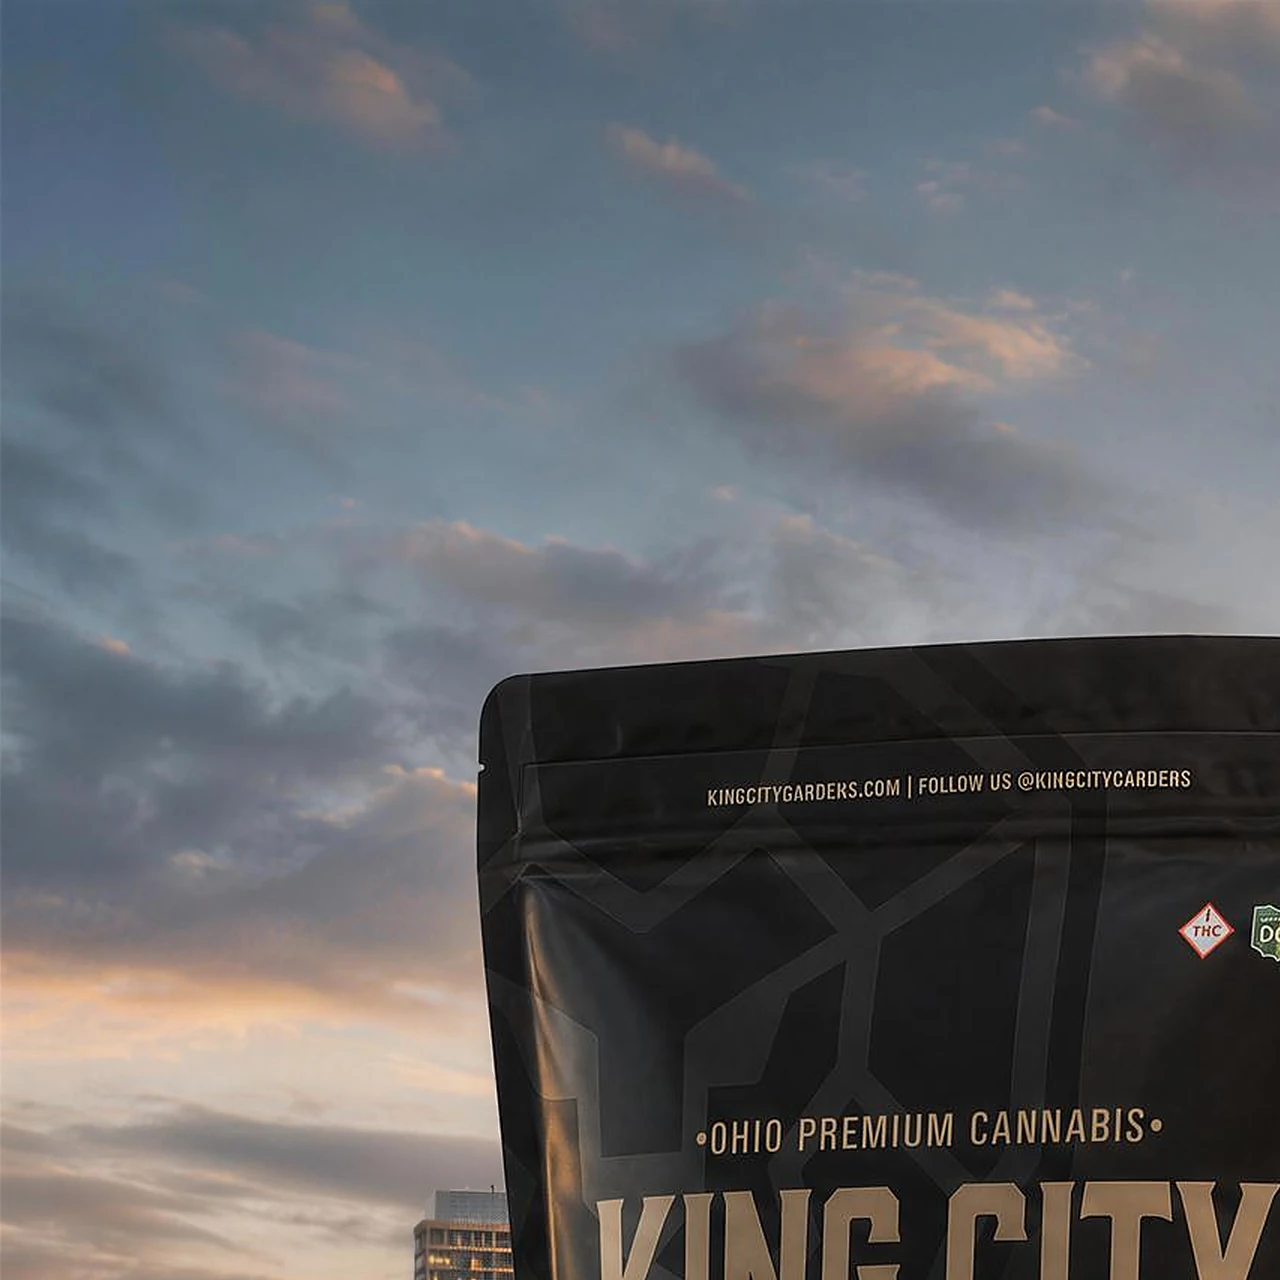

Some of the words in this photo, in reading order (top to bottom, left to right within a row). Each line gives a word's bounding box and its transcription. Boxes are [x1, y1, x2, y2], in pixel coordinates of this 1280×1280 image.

[919, 774, 984, 795] FOLLOW
[990, 773, 1012, 791] US
[1192, 924, 1222, 938] THC
[710, 1119, 782, 1155] OHIO
[798, 1112, 954, 1152] PREMIUM
[970, 1108, 1146, 1146] CANNABIS
